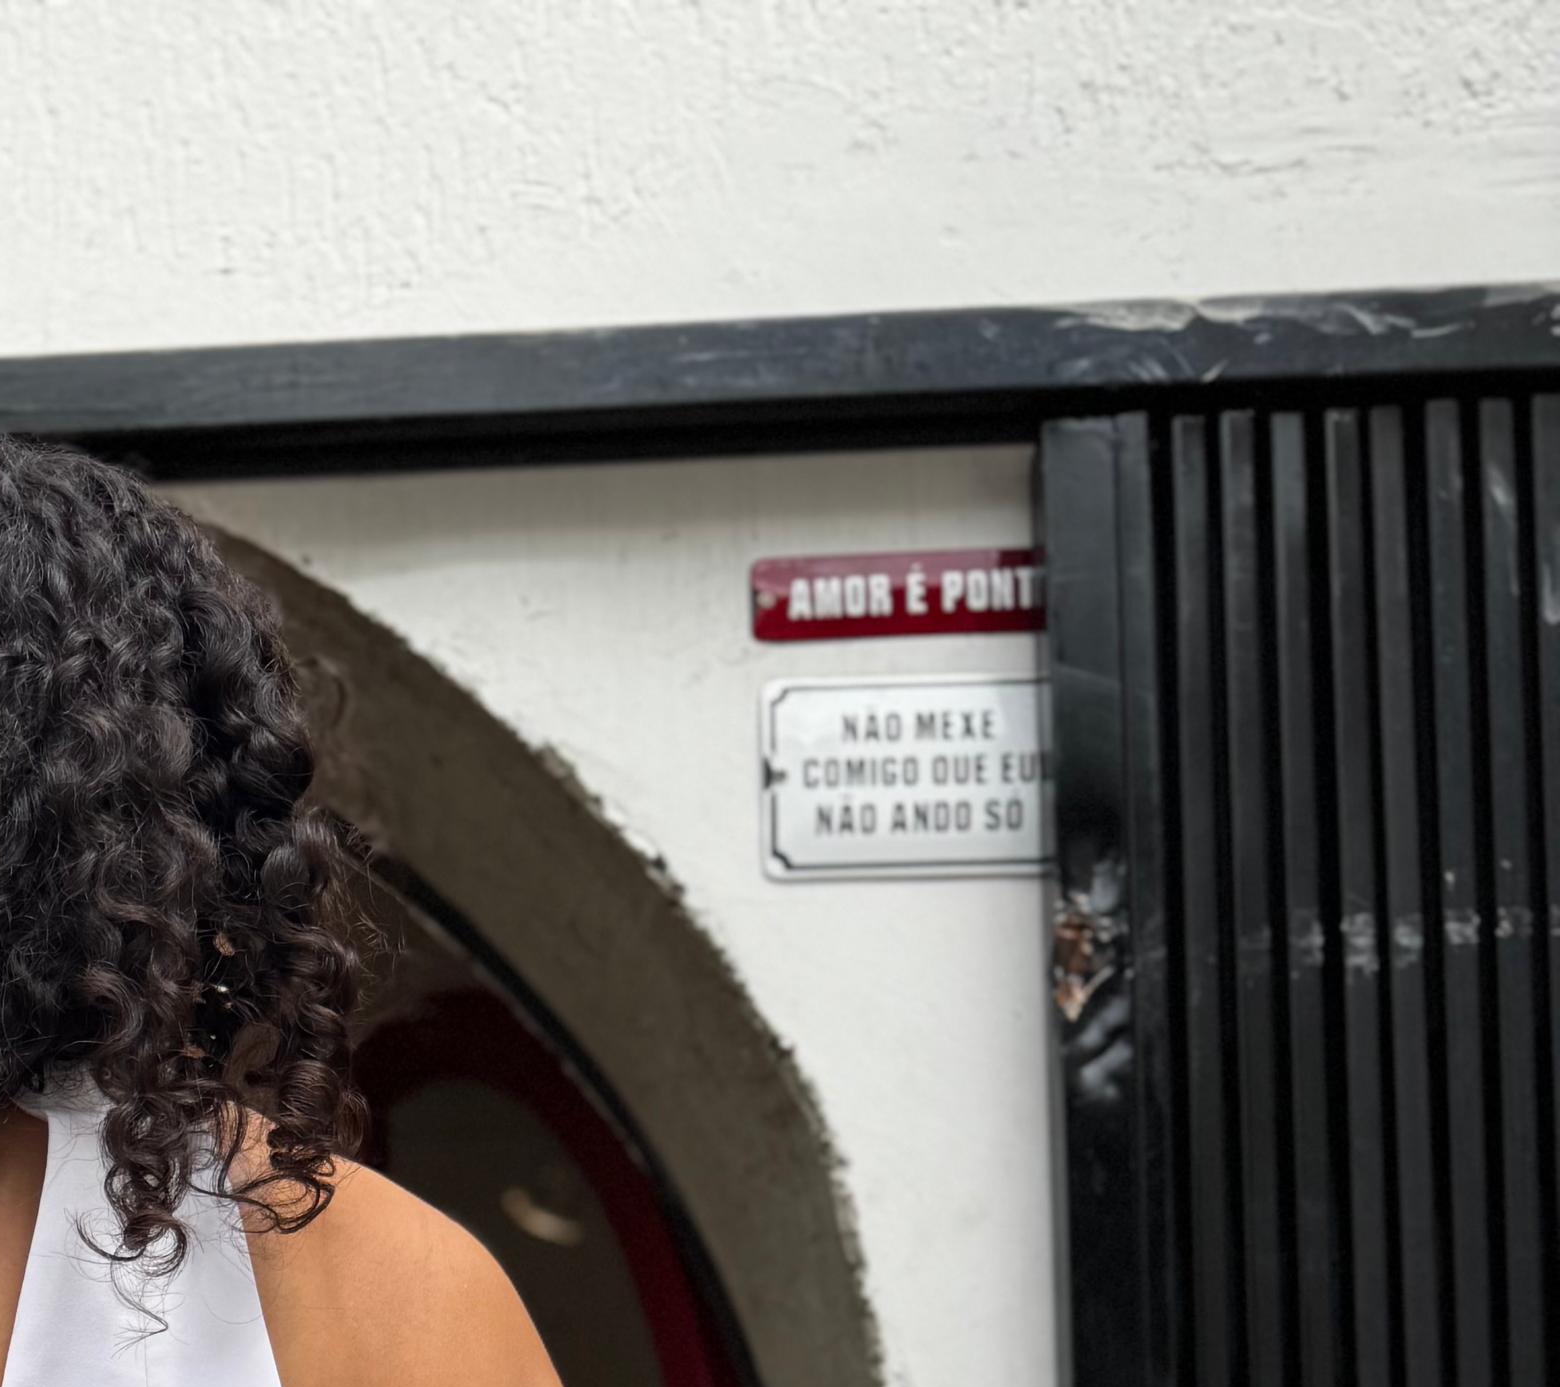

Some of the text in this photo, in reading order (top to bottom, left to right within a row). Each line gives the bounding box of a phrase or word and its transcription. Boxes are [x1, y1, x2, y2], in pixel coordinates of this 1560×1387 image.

[788, 574, 892, 620] AMOR
[906, 561, 928, 616] É
[915, 710, 994, 740] MEXE
[803, 756, 919, 788] COMIGO
[816, 793, 876, 835] NÃO
[891, 801, 971, 833] ANDO
